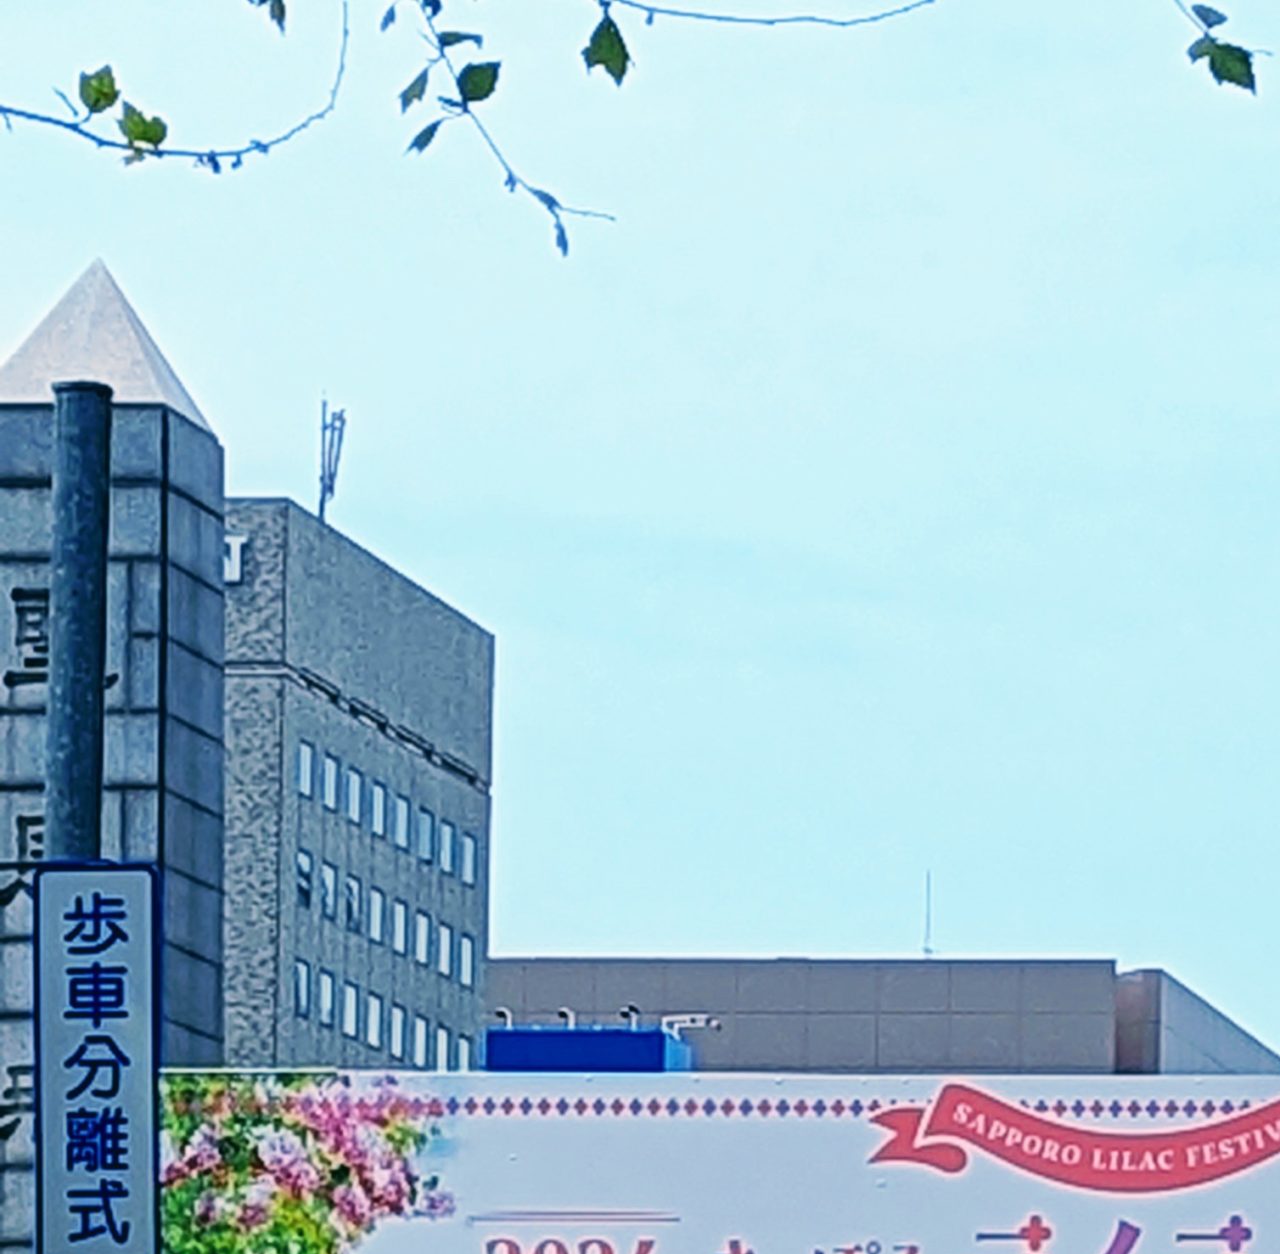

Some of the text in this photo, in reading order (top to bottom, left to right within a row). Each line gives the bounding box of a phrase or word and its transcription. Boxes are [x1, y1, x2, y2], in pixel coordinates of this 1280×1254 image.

[63, 891, 131, 1245] 歩車分離式
[952, 1102, 1082, 1165] SAPPORO
[1092, 1147, 1175, 1172] LILAC
